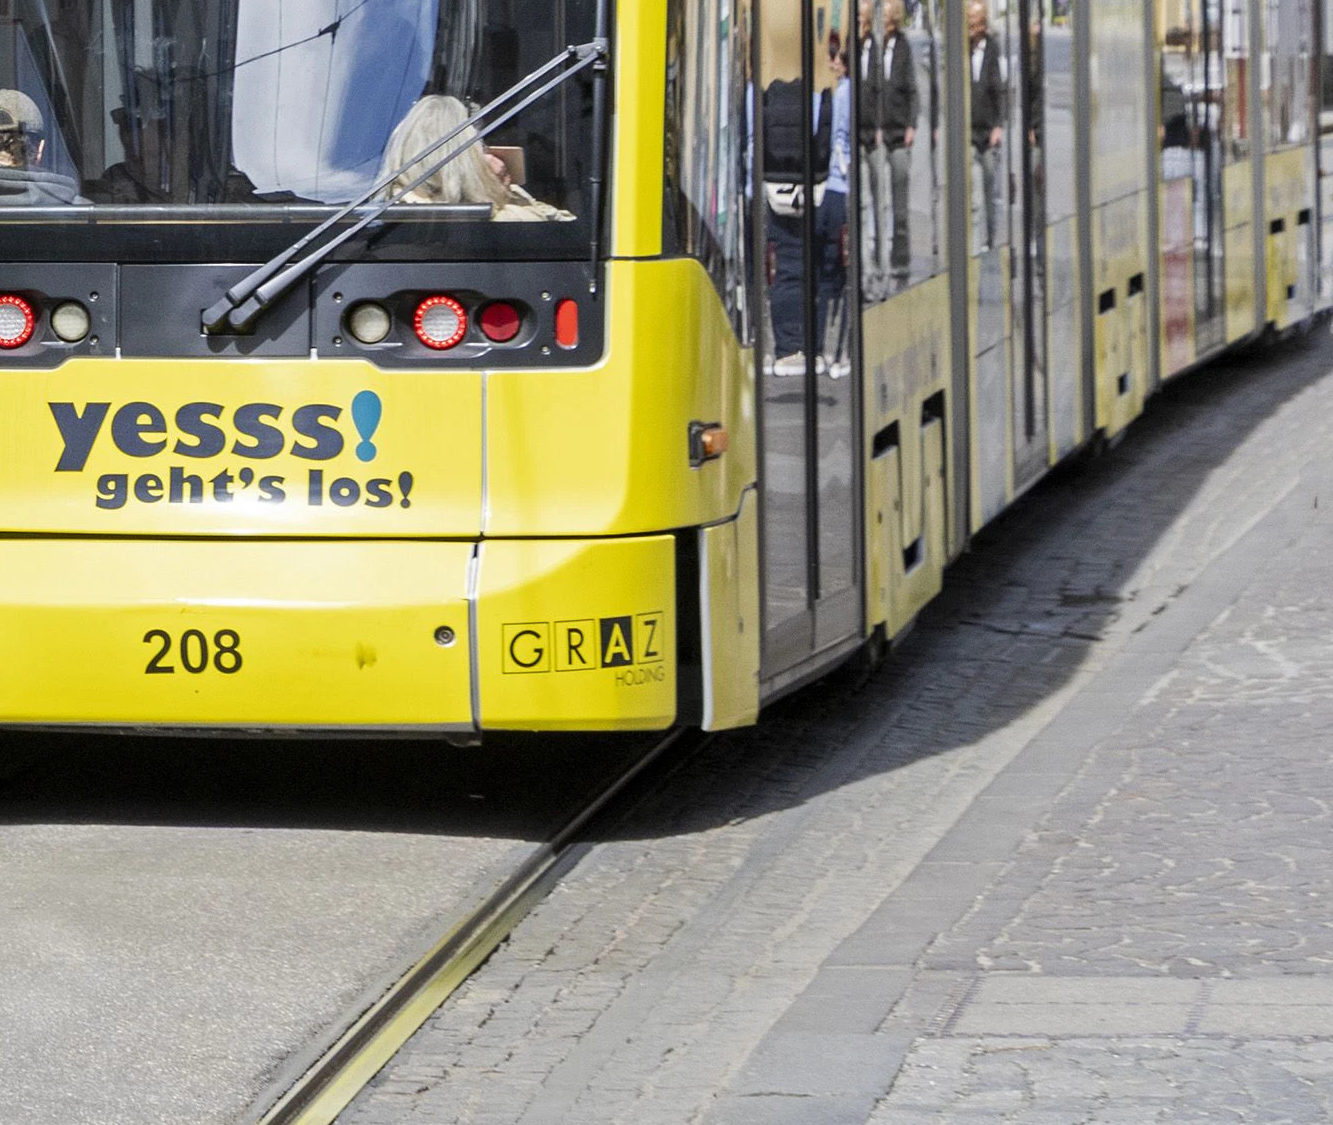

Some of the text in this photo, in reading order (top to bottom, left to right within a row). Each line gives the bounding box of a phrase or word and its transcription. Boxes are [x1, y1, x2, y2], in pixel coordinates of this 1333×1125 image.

[47, 389, 383, 473] yesss!
[94, 465, 415, 511] geht's los!
[142, 628, 243, 674] 208
[508, 618, 659, 669] GRAZ
[614, 666, 666, 687] HOLDING
